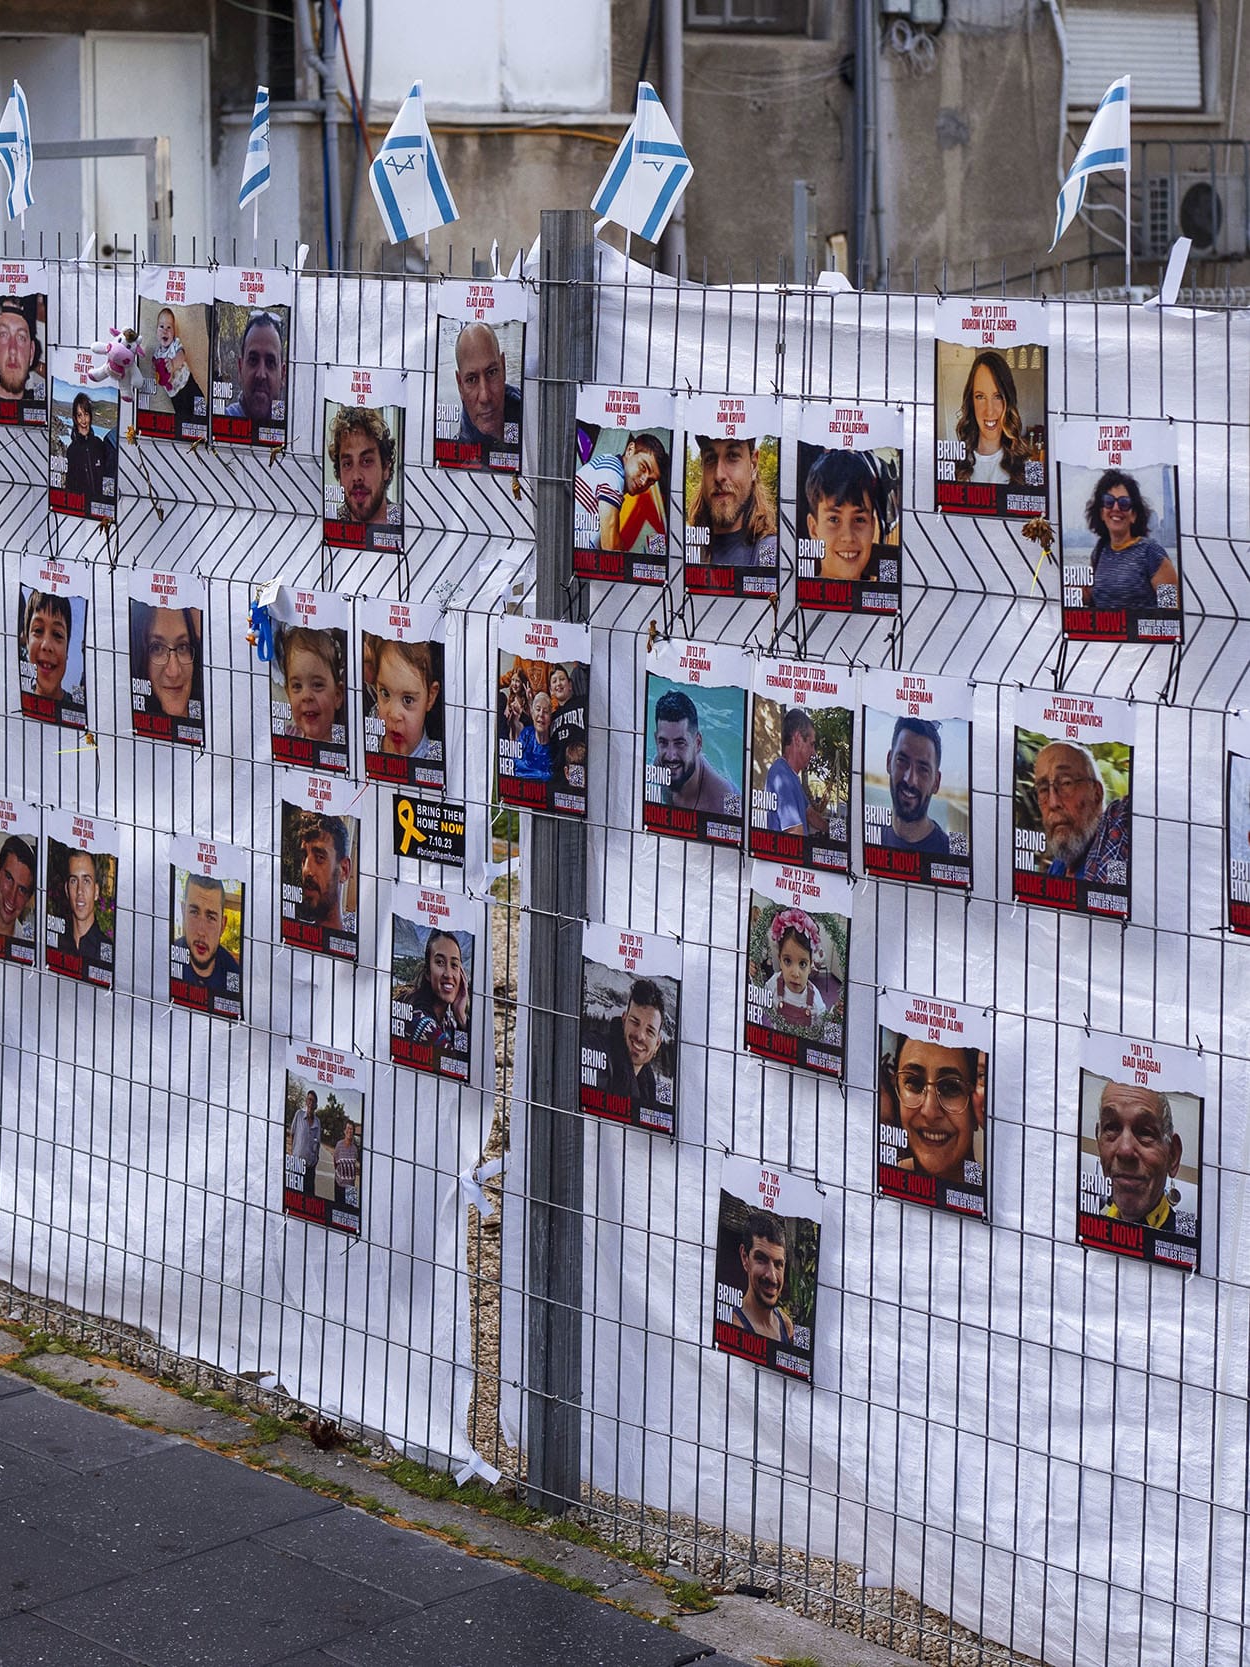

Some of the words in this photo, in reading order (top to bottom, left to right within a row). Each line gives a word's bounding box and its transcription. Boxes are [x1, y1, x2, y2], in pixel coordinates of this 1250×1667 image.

[962, 319, 980, 331] DORON
[982, 320, 996, 331] KATZ
[997, 320, 1017, 332] ASHER
[982, 332, 995, 345] (34)
[436, 404, 459, 421] BRING
[616, 415, 627, 426] (35)
[725, 424, 735, 436] (25)
[829, 422, 841, 433] EREZ
[842, 423, 869, 435] KALDERON
[842, 435, 853, 447] (12)
[937, 440, 966, 460] BRING
[1098, 439, 1111, 451] LIAT
[1108, 452, 1121, 466] (49)
[937, 461, 956, 481] HER
[937, 484, 965, 504] HOME
[967, 484, 996, 506] NOW!
[574, 512, 600, 532] BRING
[573, 531, 591, 549] HIM
[685, 527, 710, 545] BRING
[685, 545, 700, 563] HIM
[798, 539, 825, 559] BRING
[573, 551, 598, 571] HOME
[599, 553, 623, 573] NOW!
[798, 559, 815, 578] HIM
[685, 567, 709, 586] HOME
[710, 568, 734, 588] NOW!
[1063, 566, 1093, 586] BRING
[798, 581, 822, 601] HOME
[825, 581, 852, 602] NOW!
[1064, 587, 1083, 607] HER
[1064, 611, 1093, 631] HOME
[1096, 609, 1127, 632] NOW!
[679, 657, 688, 668] ZIV
[688, 658, 711, 671] BERMAN
[133, 678, 151, 696] BRING
[688, 671, 700, 683] (26)
[766, 675, 792, 689] FERNANDO
[793, 677, 811, 691] SIMON
[812, 680, 837, 695] MARMAN
[133, 694, 145, 711] HER
[794, 691, 806, 704] (60)
[896, 688, 908, 700] GALI
[909, 689, 933, 704] BERMAN
[272, 700, 291, 720] BRING
[563, 708, 584, 730] YORK
[908, 703, 920, 716] (26)
[1043, 707, 1058, 721] ARYE
[1059, 709, 1102, 728] ZALMANOVICH
[272, 717, 285, 735] HER
[365, 717, 385, 736] BRING
[1065, 724, 1078, 739] (85)
[365, 735, 378, 752] HER
[499, 738, 522, 759] BRING
[499, 758, 514, 777] HER
[646, 766, 671, 786] BRING
[499, 778, 519, 798] HOME
[645, 784, 662, 803] HIM
[752, 789, 777, 811] BRING
[417, 804, 440, 818] BRING
[443, 809, 464, 821] THEM
[644, 804, 669, 826] HOME
[672, 808, 697, 831] NOW!
[751, 809, 767, 829] HIM
[865, 804, 892, 826] BRING
[417, 818, 438, 831] HOME
[441, 823, 464, 836] NOW
[865, 826, 882, 845] HIM
[428, 835, 452, 849] 7.10.23
[751, 832, 775, 851] HOME
[777, 834, 803, 857] NOW!
[1015, 828, 1046, 853] BRING
[417, 847, 464, 865] #bringthemhome
[865, 850, 890, 870] HOME
[892, 853, 920, 874] NOW!
[1015, 850, 1034, 872] HIM
[282, 882, 302, 903] BRING
[775, 877, 787, 889] AVIV
[787, 879, 801, 893] KATZ
[801, 883, 820, 898] ASHER
[1015, 872, 1043, 896] HOME
[1046, 877, 1077, 902] NOW!
[792, 893, 800, 906] (2)
[282, 902, 295, 919] HIM
[627, 946, 643, 959] FORTI
[624, 958, 635, 970] (30)
[747, 984, 773, 1009] BRING
[392, 1000, 413, 1021] BRING
[747, 1003, 763, 1024] HER
[391, 1020, 405, 1037] HER
[905, 1010, 928, 1025] SHARON
[947, 1018, 964, 1033] ALONI
[747, 1023, 770, 1046] HOME
[772, 1029, 797, 1056] NOW!
[928, 1028, 940, 1042] (34)
[581, 1047, 607, 1071] BRING
[1122, 1056, 1135, 1069] GAD
[1137, 1057, 1161, 1074] HAGGAI
[581, 1066, 597, 1087] HIM
[1134, 1071, 1148, 1086] (73)
[581, 1087, 606, 1110] HOME
[607, 1094, 631, 1117] NOW!
[879, 1123, 908, 1149] BRING
[285, 1154, 306, 1175] BRING
[879, 1144, 897, 1167] HER
[285, 1171, 303, 1192] THEM
[758, 1182, 766, 1194] OR
[767, 1184, 781, 1198] LEVY
[879, 1167, 906, 1191] HOME
[907, 1173, 936, 1199] NOW!
[1081, 1172, 1112, 1197] BRING
[763, 1196, 774, 1210] (33)
[1080, 1194, 1100, 1215] HIM
[1079, 1215, 1109, 1241] HOME
[1111, 1223, 1143, 1249] NOW!
[717, 1282, 742, 1308] BRING
[716, 1305, 733, 1324] HIM
[715, 1323, 740, 1347] HOME
[742, 1330, 767, 1358] NOW!
